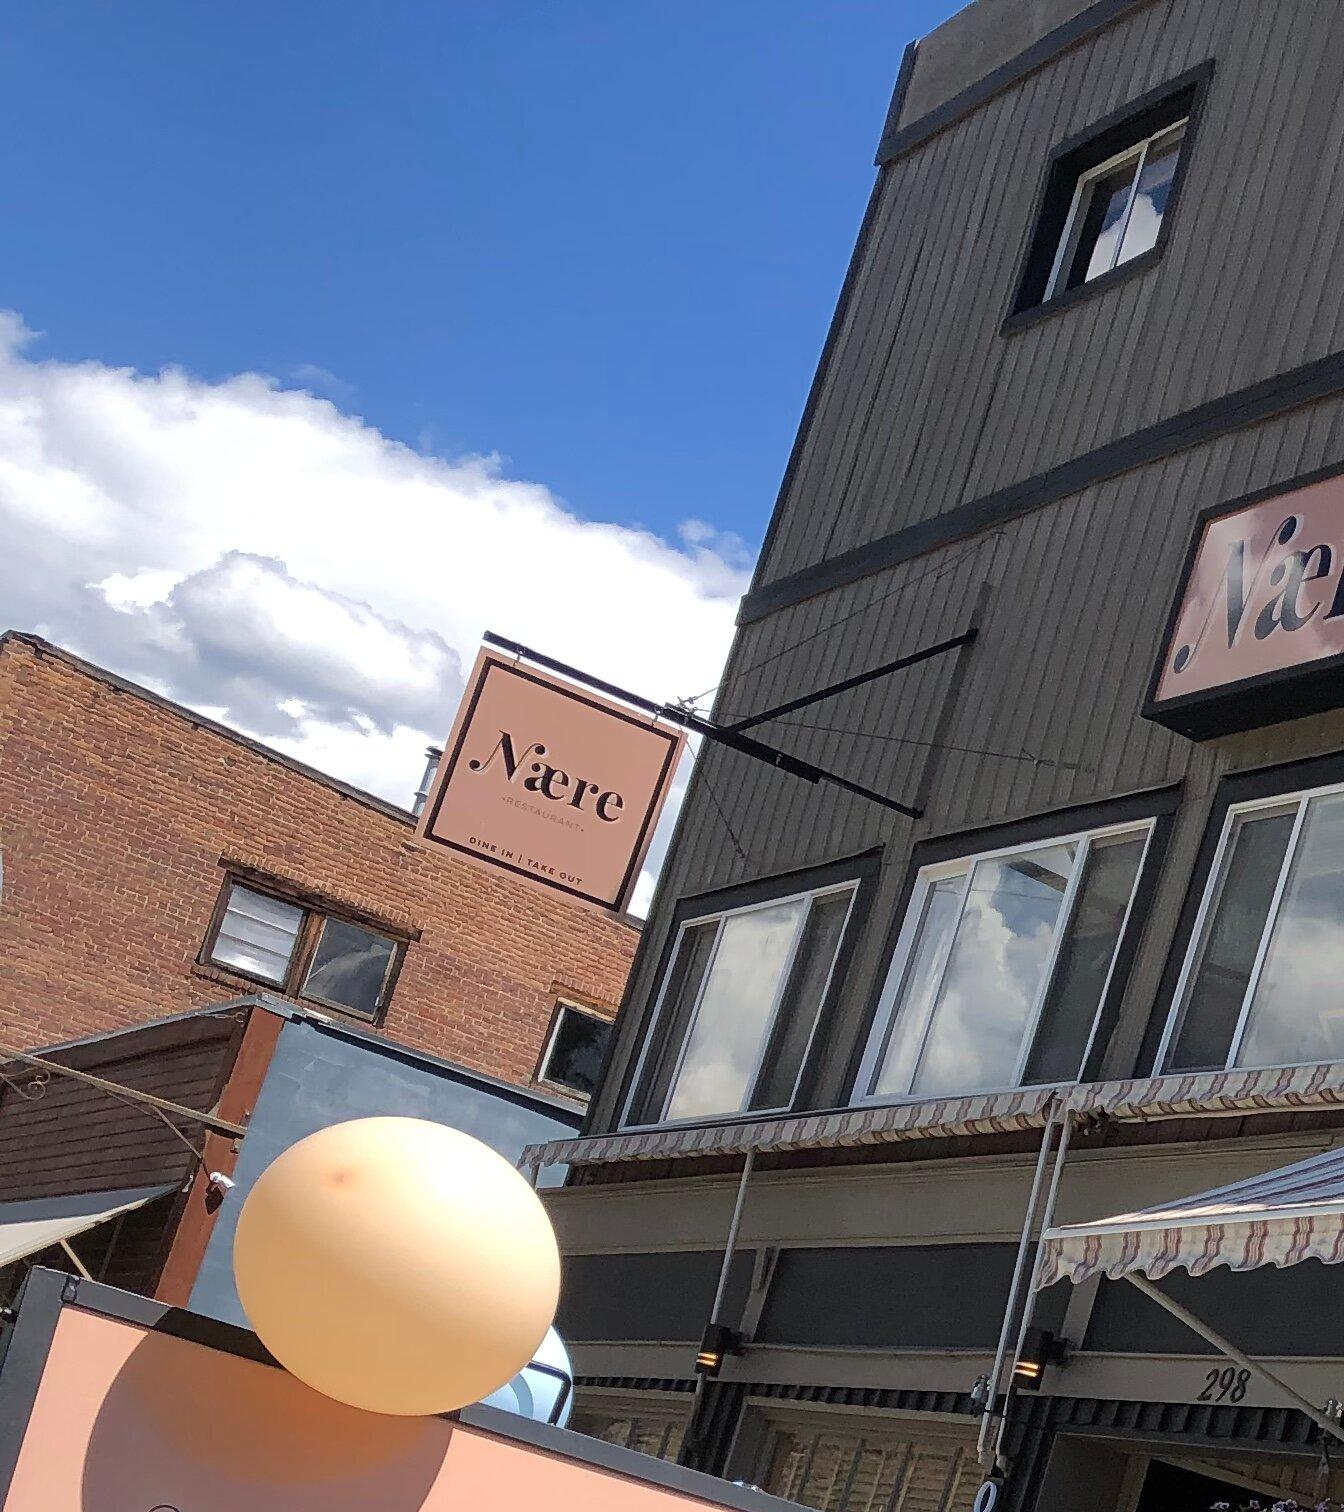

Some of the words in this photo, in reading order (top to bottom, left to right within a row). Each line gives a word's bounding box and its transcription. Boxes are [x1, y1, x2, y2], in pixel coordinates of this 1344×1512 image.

[469, 729, 624, 822] Nære
[469, 836, 497, 852] DINE
[501, 848, 513, 859] IN
[527, 858, 555, 875] TAKE
[559, 872, 583, 885] OUT
[1196, 1366, 1251, 1403] 298
